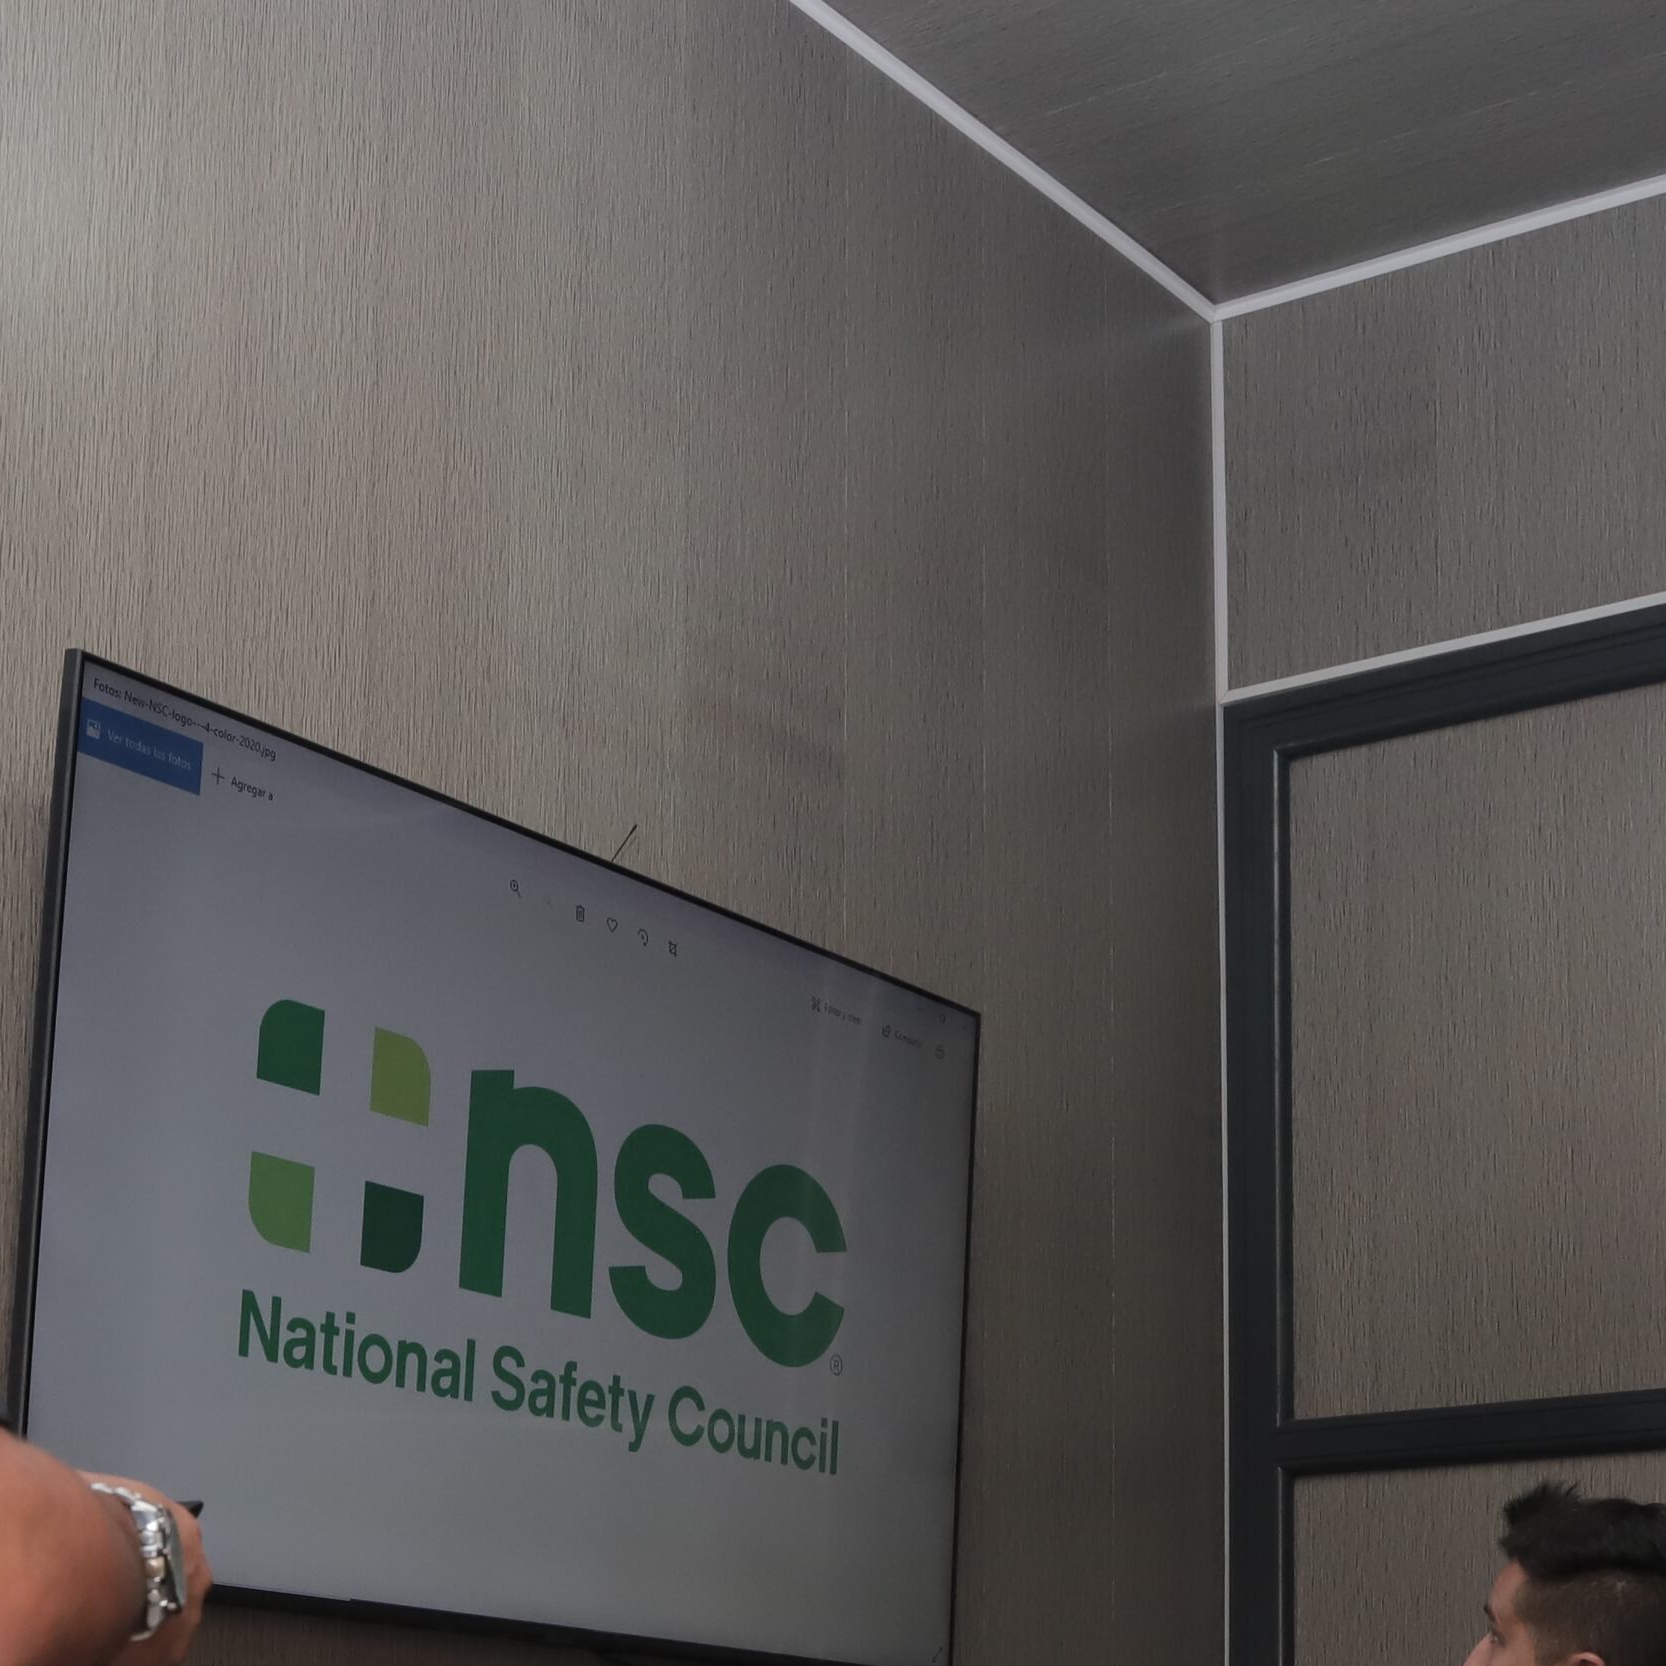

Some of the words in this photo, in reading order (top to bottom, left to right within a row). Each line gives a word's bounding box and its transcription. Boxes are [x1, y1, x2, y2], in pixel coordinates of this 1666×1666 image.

[93, 677, 122, 699] Fotos:
[106, 728, 123, 743] Ver
[124, 736, 151, 757] todas
[167, 749, 193, 771] fotos
[230, 775, 266, 799] Agregar
[458, 1068, 848, 1368] nsc
[238, 1288, 476, 1402] National
[490, 1344, 656, 1453] Safety
[668, 1385, 840, 1476] Council
